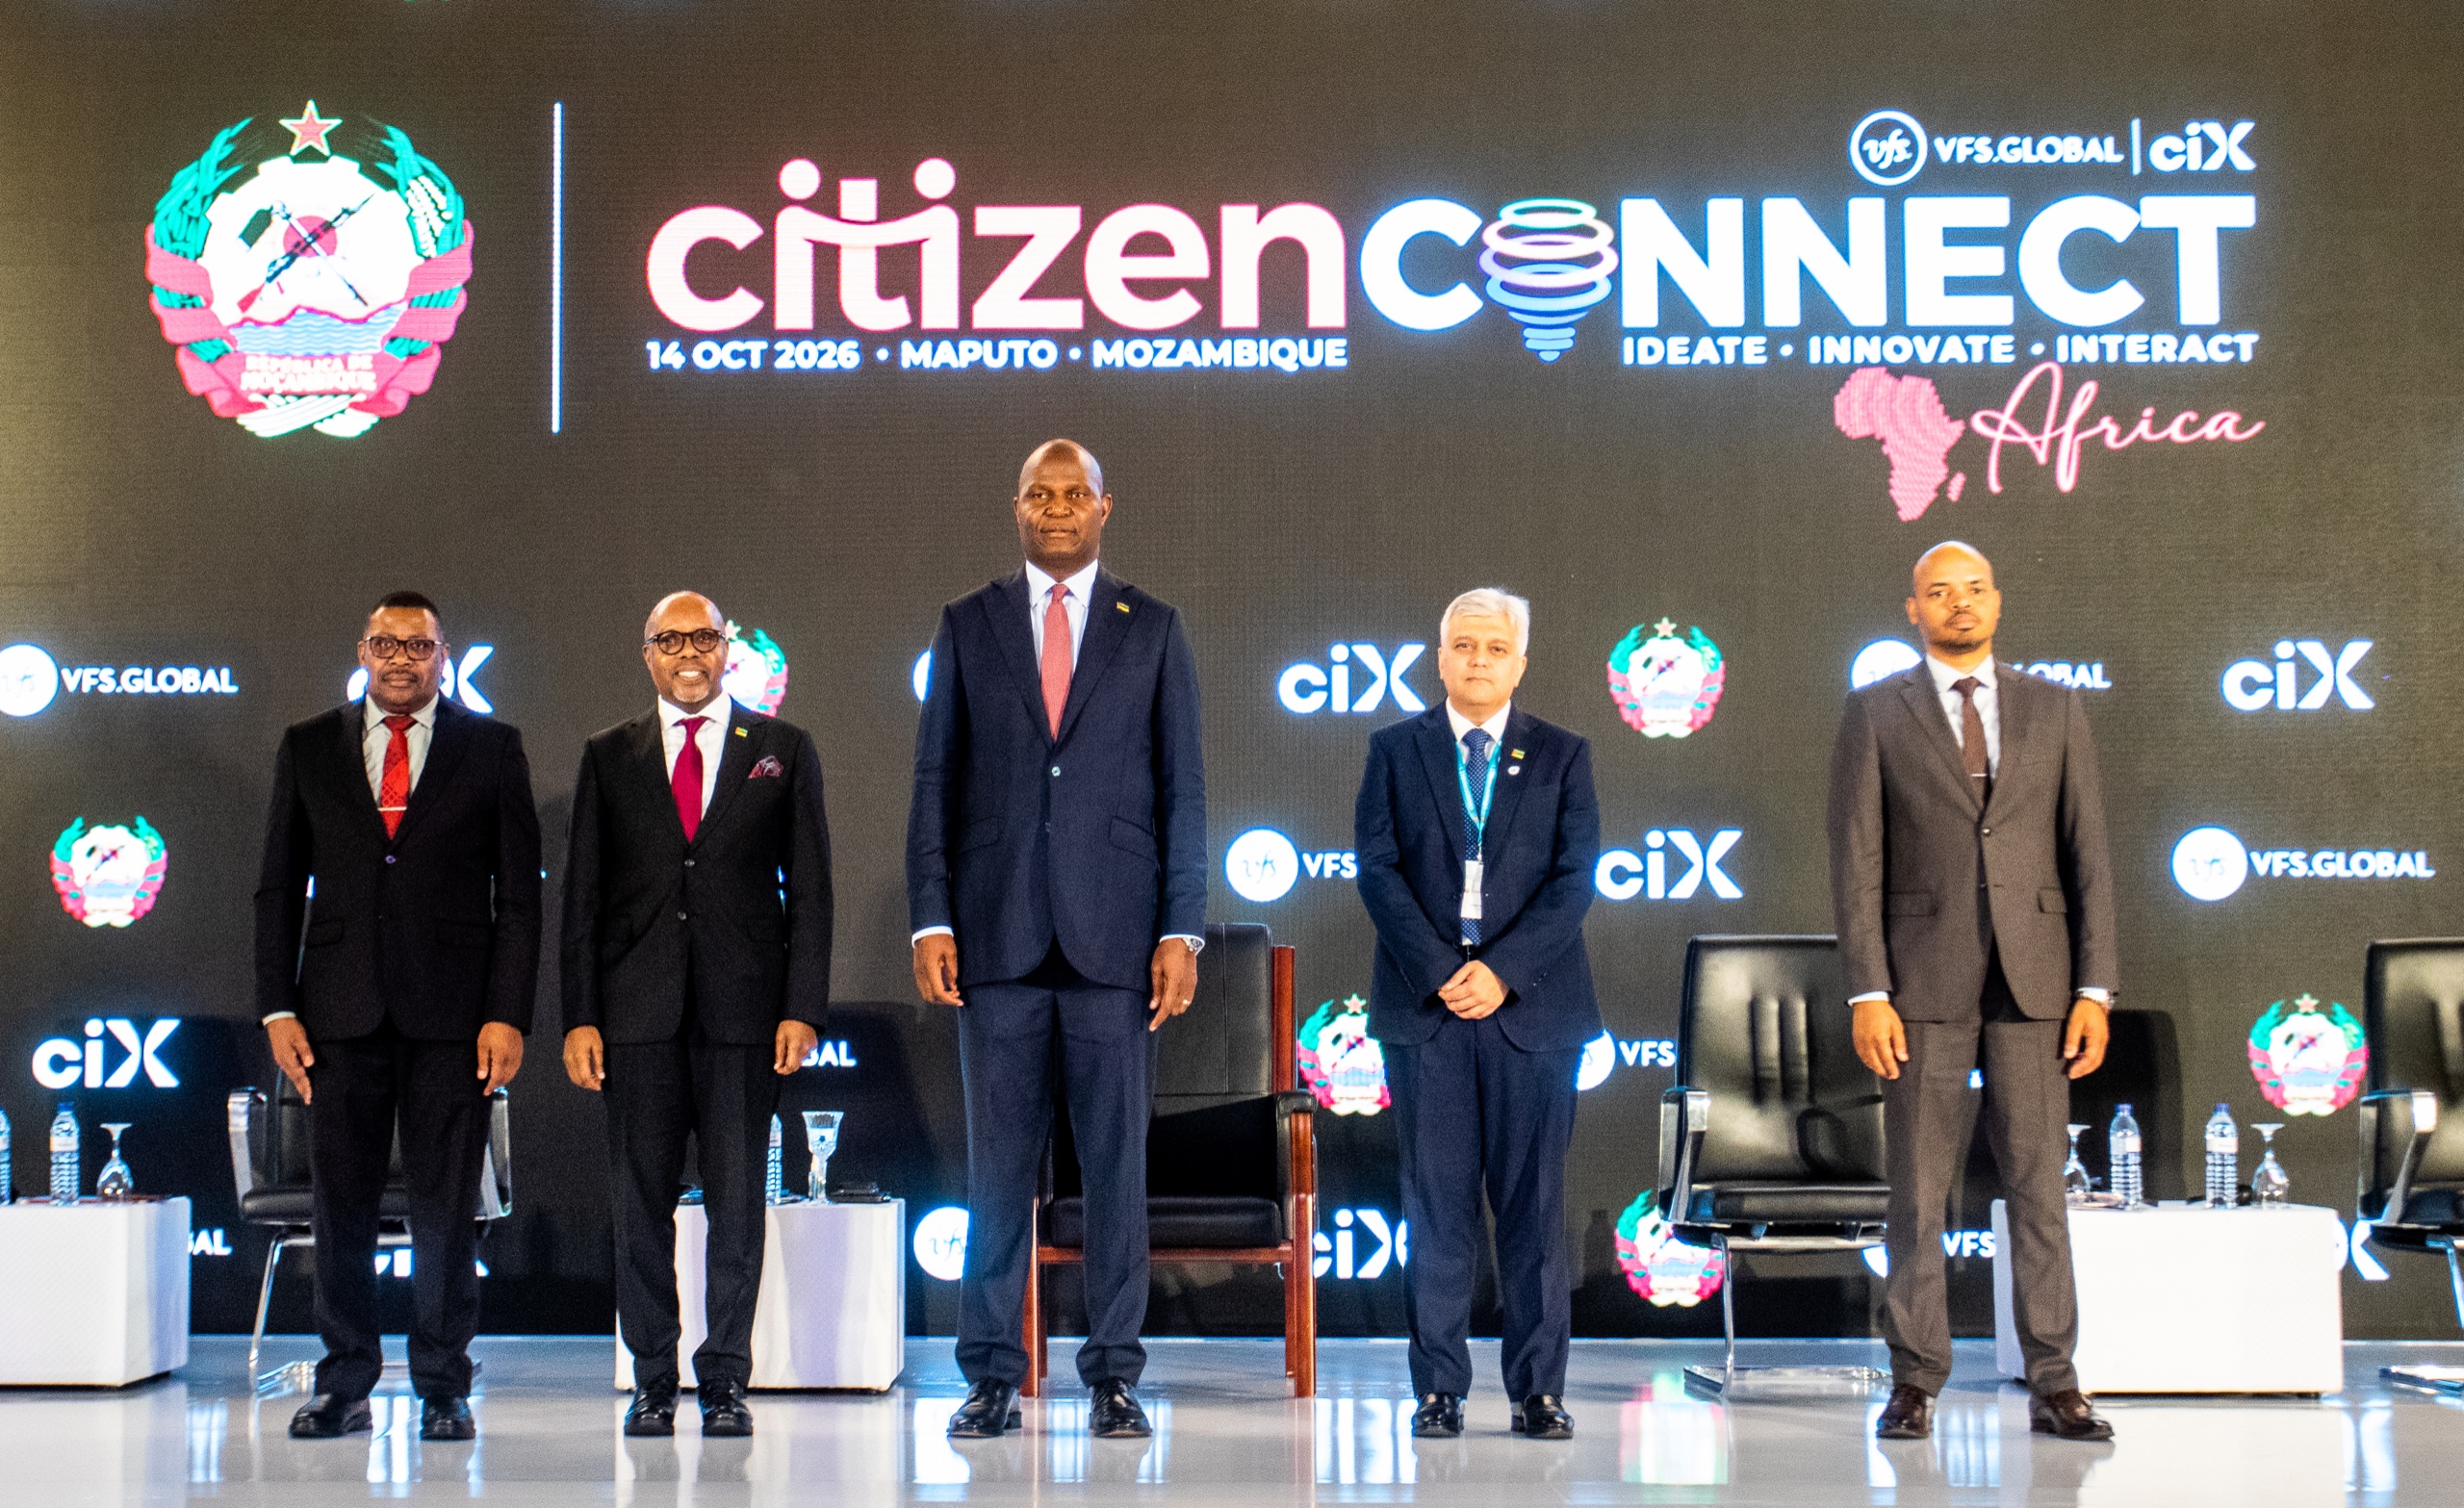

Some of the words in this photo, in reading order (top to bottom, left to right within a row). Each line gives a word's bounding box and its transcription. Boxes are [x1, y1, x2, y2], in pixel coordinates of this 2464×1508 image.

[1933, 136, 2124, 164] VFS.GLOBAL
[2149, 121, 2256, 171] ciX
[646, 342, 685, 370] 14
[692, 341, 768, 370] OCT
[774, 341, 860, 370] 2026
[901, 340, 1058, 369] MAPUTO
[1092, 338, 1348, 372] MOZAMBIQUE
[1623, 336, 1767, 365] IDEATE
[1810, 335, 2015, 365] INNOVATE
[2056, 334, 2260, 364] INTERACT
[1971, 361, 2267, 494] Africa
[61, 666, 239, 694] VFS.GLOBAL
[1277, 643, 1427, 714] ciX
[2221, 639, 2375, 712] ciX
[1594, 830, 1744, 901] ciX
[2249, 850, 2436, 878] VFS.GLOBAL
[31, 1017, 180, 1089] ciX
